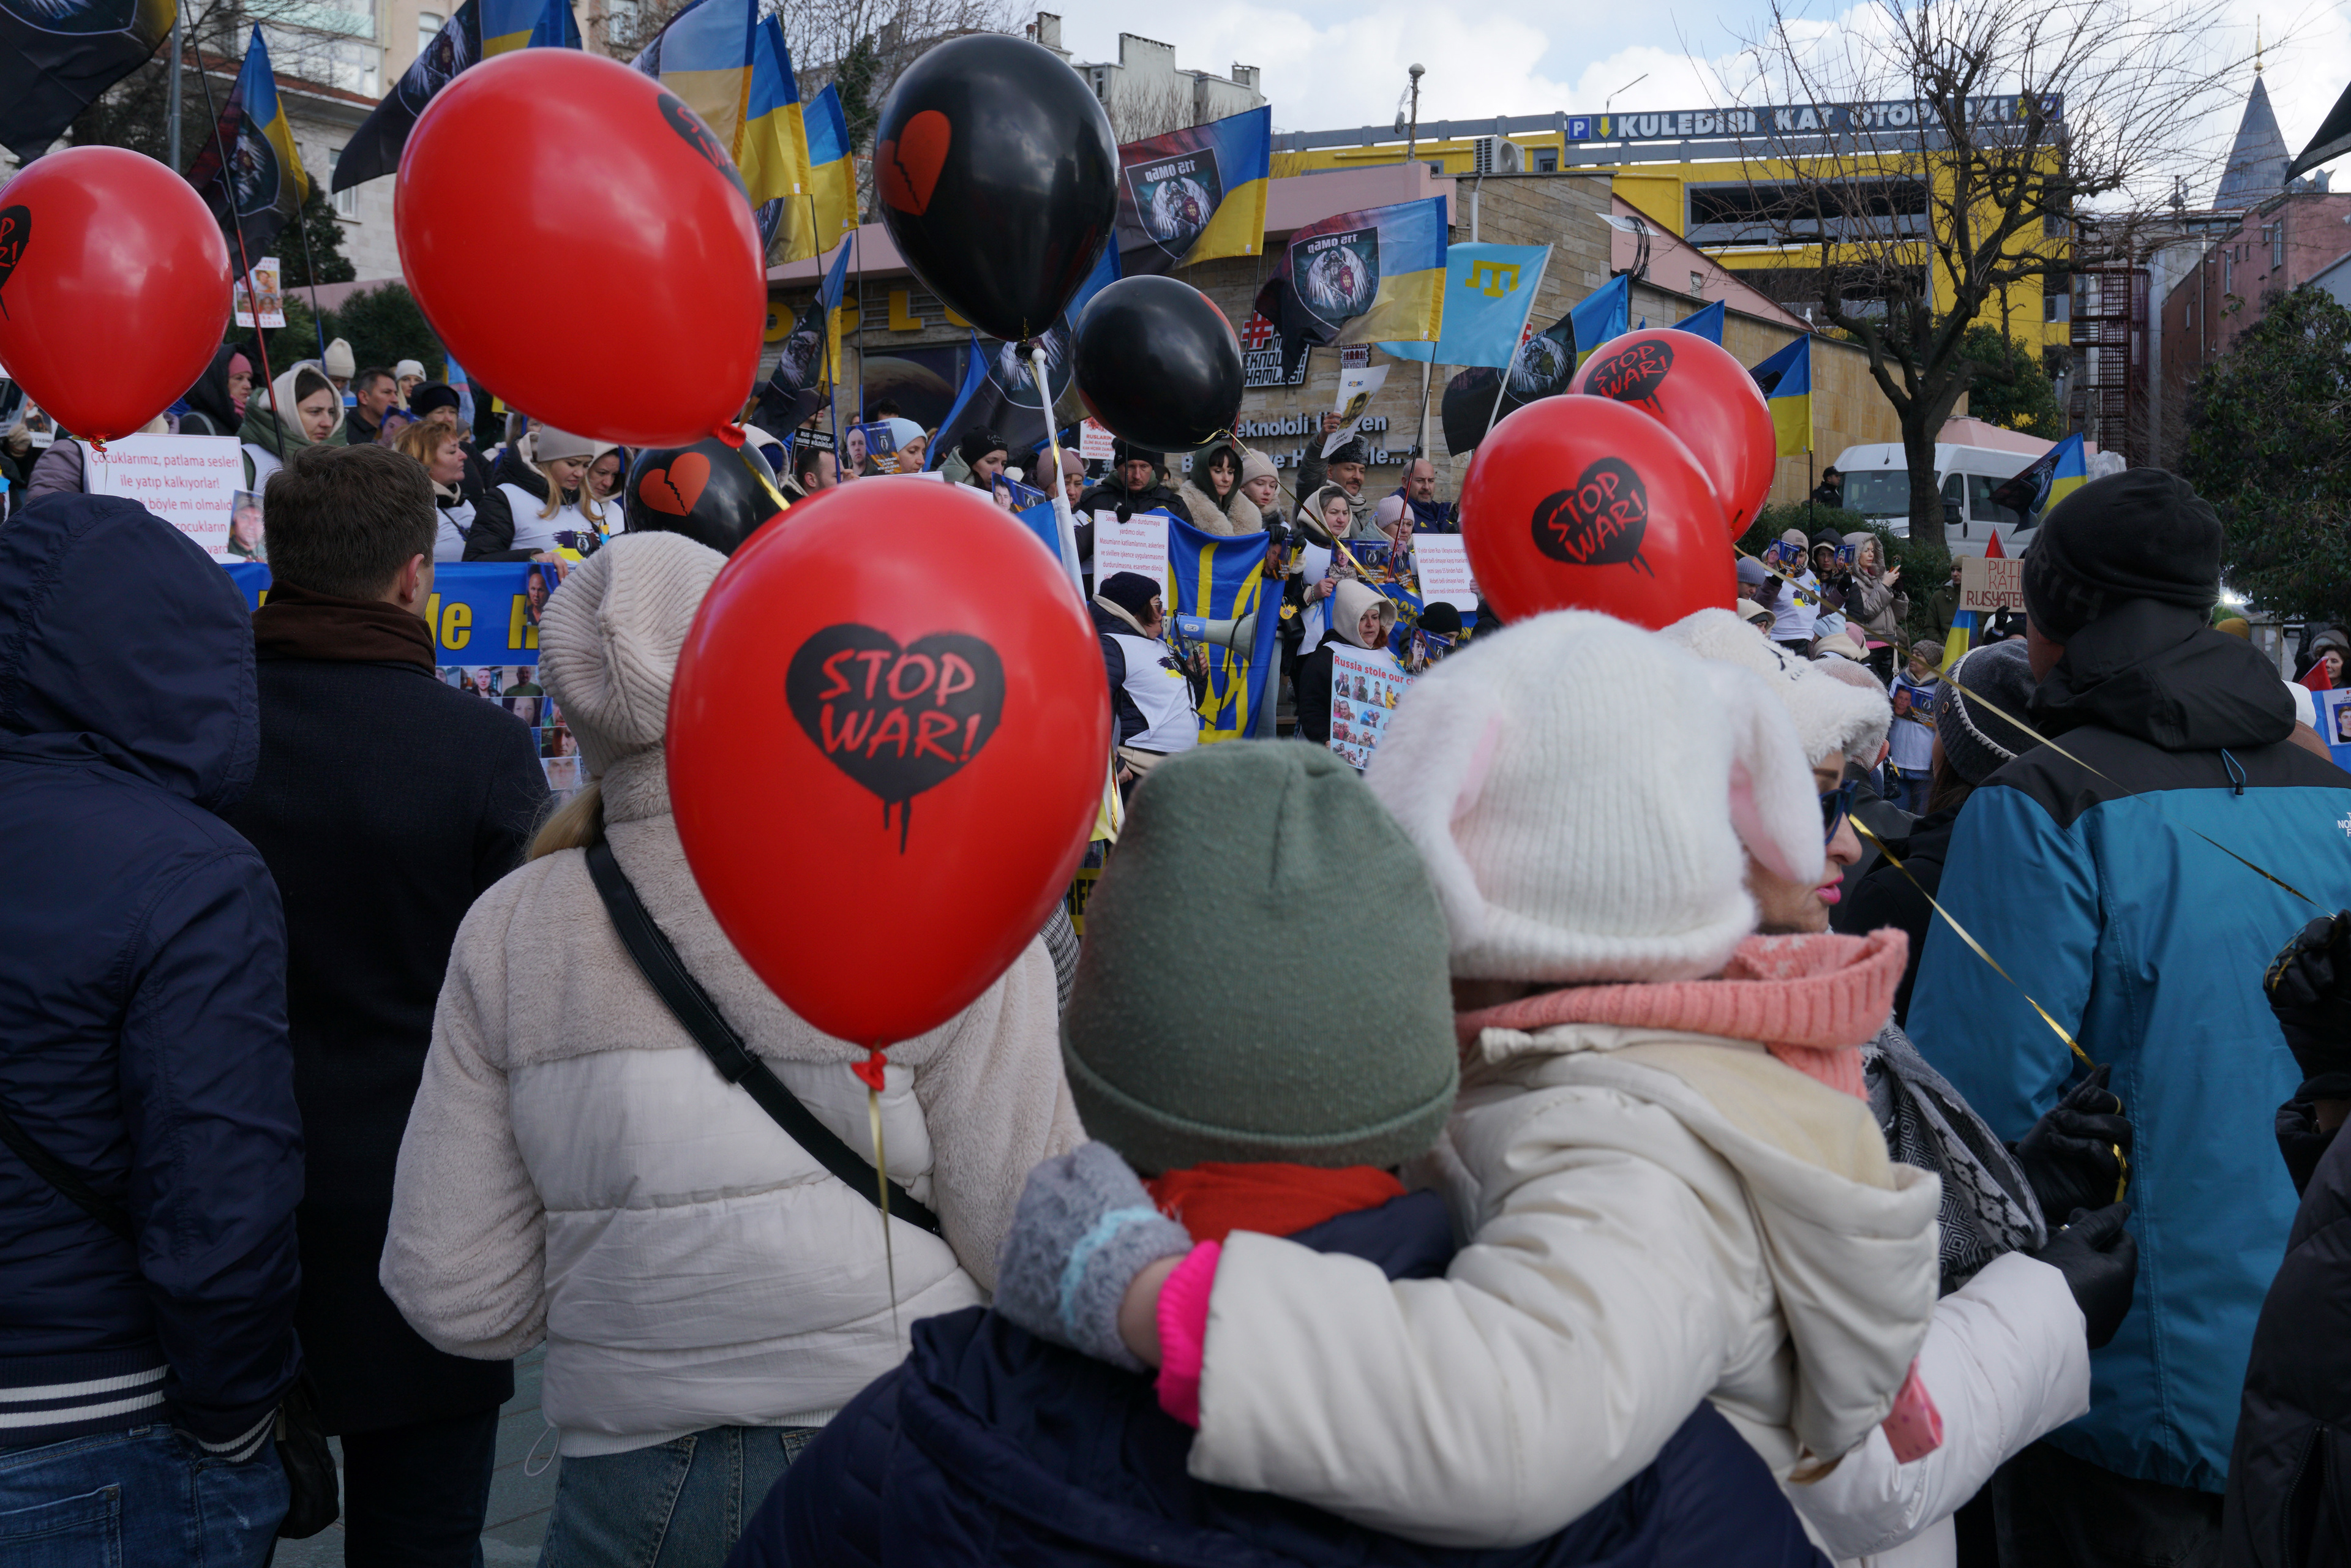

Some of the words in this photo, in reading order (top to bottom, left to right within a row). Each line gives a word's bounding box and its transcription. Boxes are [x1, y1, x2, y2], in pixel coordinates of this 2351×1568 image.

[1618, 107, 1756, 138] KULEDİBİ
[1775, 107, 1833, 132] KAT
[1594, 345, 1655, 389] STOP
[1600, 354, 1669, 400] WAR!
[1225, 413, 1308, 438] eknoloji
[91, 451, 162, 467] Çocuklarımız,
[164, 454, 205, 468] patlama
[208, 456, 239, 468] sesleri
[120, 475, 133, 487] ile
[135, 476, 162, 490] yatıp
[163, 476, 220, 490] kalkıyorlar!
[149, 497, 177, 512] böyle
[180, 498, 193, 510] mi
[1548, 471, 1619, 543] STOP
[1564, 489, 1646, 563] WAR!
[1989, 575, 2023, 591] KATİ
[819, 648, 976, 707] STOP
[1334, 655, 1362, 672] Russia
[1365, 666, 1386, 679] stole
[1389, 673, 1404, 683] our
[820, 702, 982, 763] WAR!
